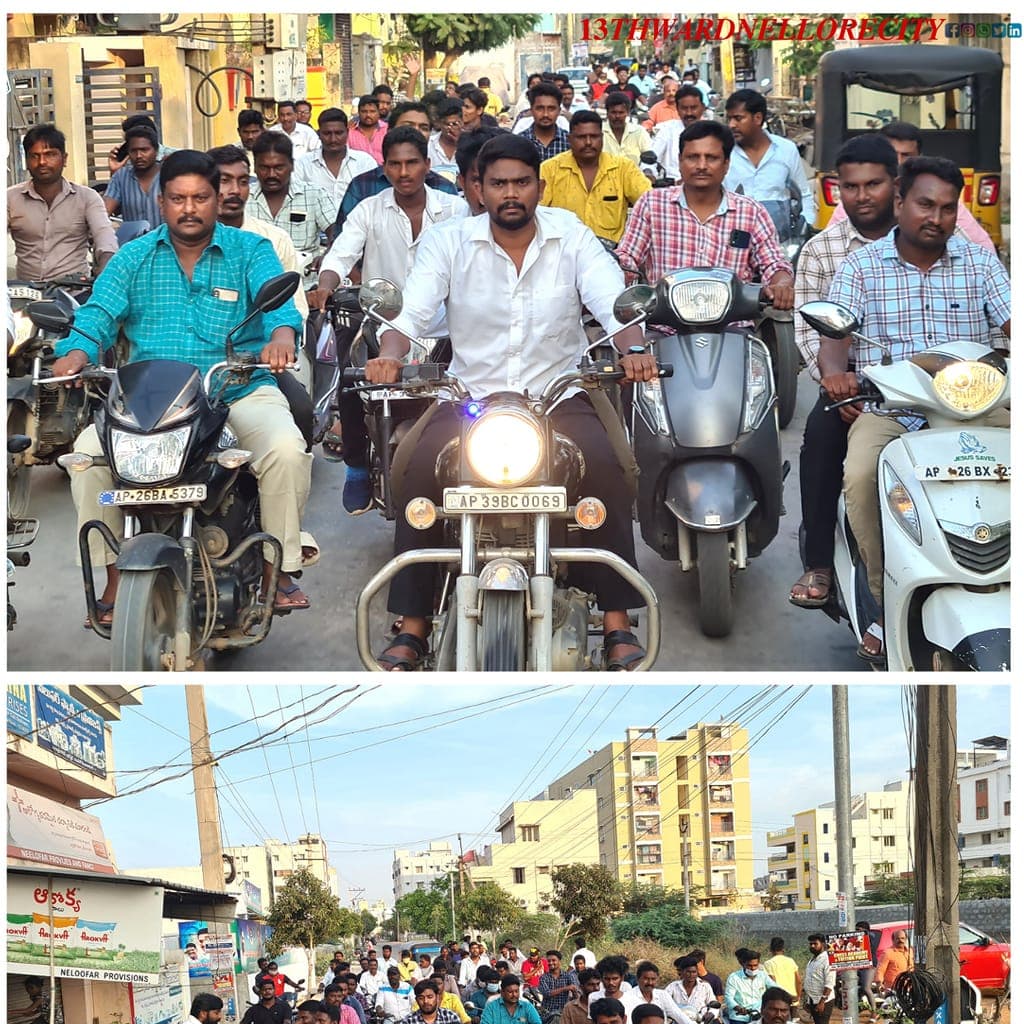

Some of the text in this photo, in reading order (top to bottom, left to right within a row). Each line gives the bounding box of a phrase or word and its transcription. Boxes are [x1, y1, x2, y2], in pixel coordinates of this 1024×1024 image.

[926, 466, 1012, 478] AP 26 BX 2
[60, 968, 149, 983] NELOOFAR PROVISIONS
